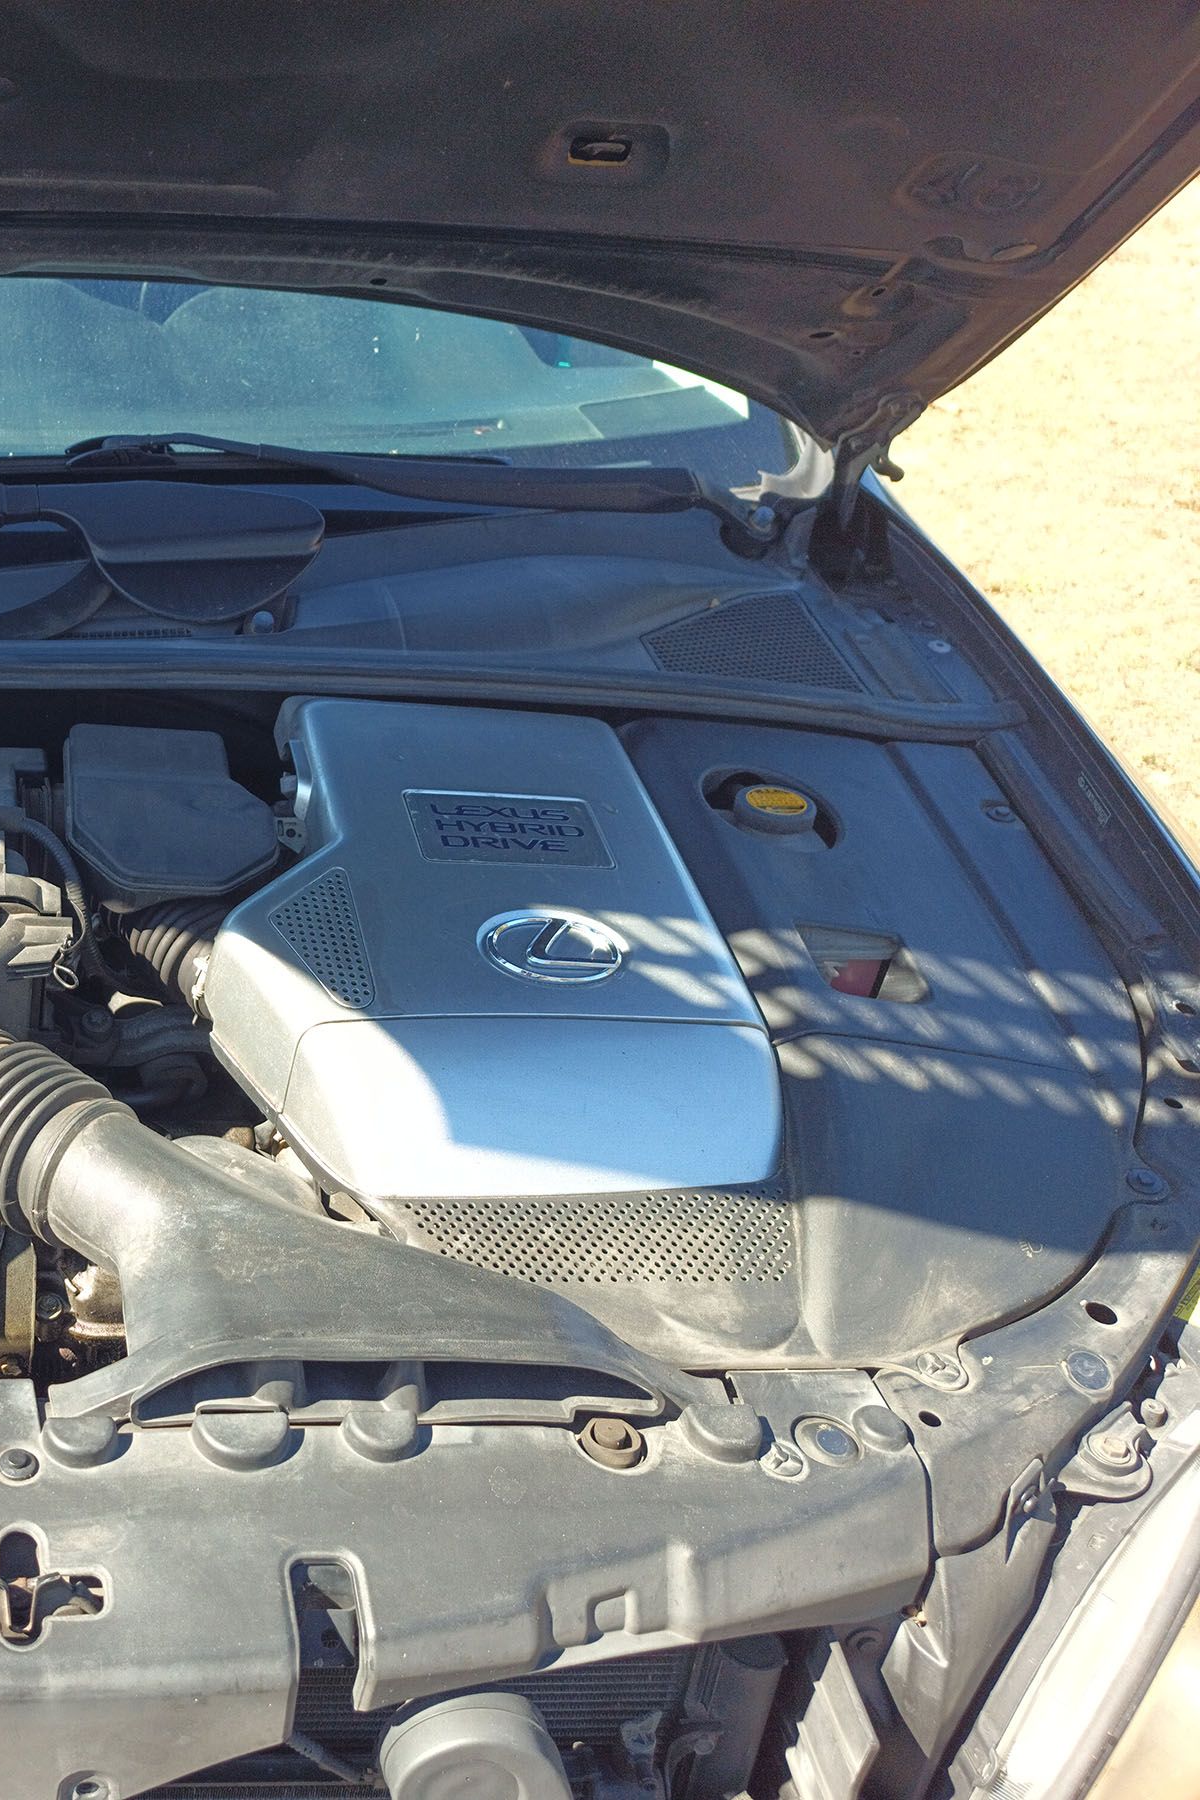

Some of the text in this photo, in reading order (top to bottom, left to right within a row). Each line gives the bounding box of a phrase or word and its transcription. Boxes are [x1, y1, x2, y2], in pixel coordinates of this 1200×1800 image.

[430, 803, 570, 821] LEXUS
[435, 819, 585, 837] HYBRID
[440, 835, 569, 852] DRIVE
